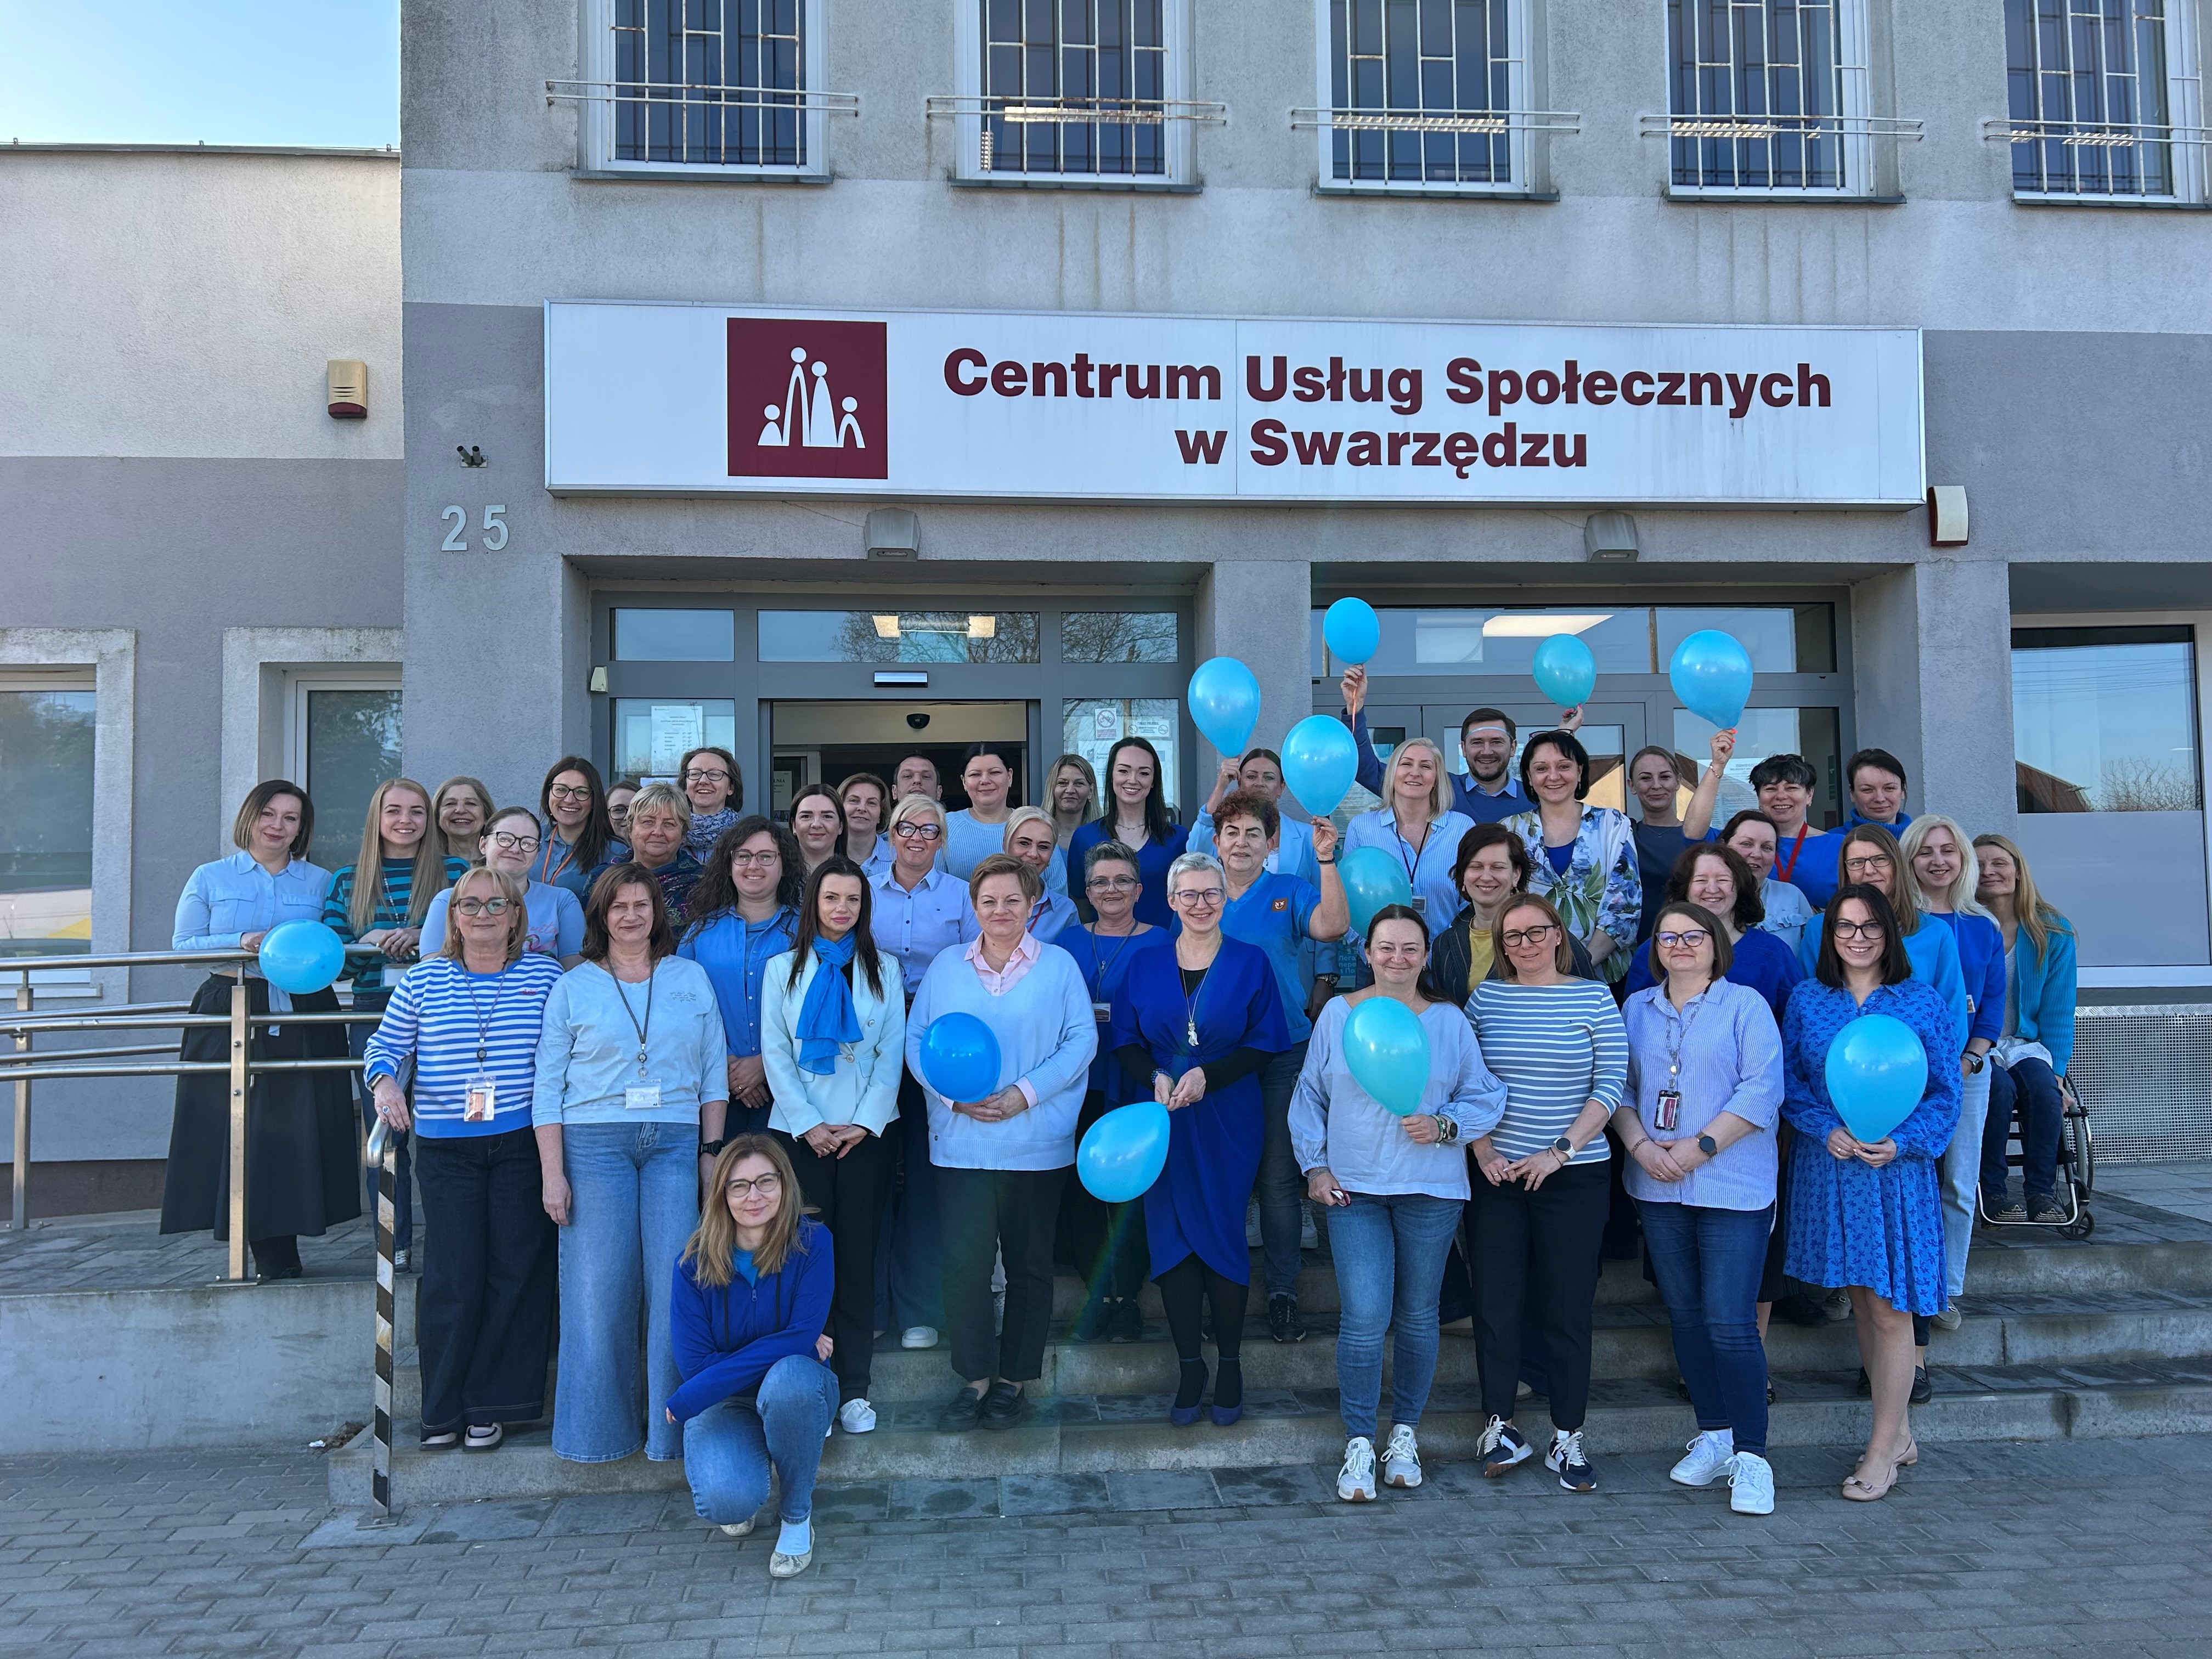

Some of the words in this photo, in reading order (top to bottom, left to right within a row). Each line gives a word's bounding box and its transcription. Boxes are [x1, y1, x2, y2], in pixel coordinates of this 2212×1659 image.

[944, 348, 1221, 400] Centrum
[1246, 356, 1423, 415] Usług
[1446, 357, 1831, 419] Społecznych
[1174, 430, 1228, 465] w
[1250, 419, 1587, 479] Swarzędzu
[441, 504, 509, 551] 25
